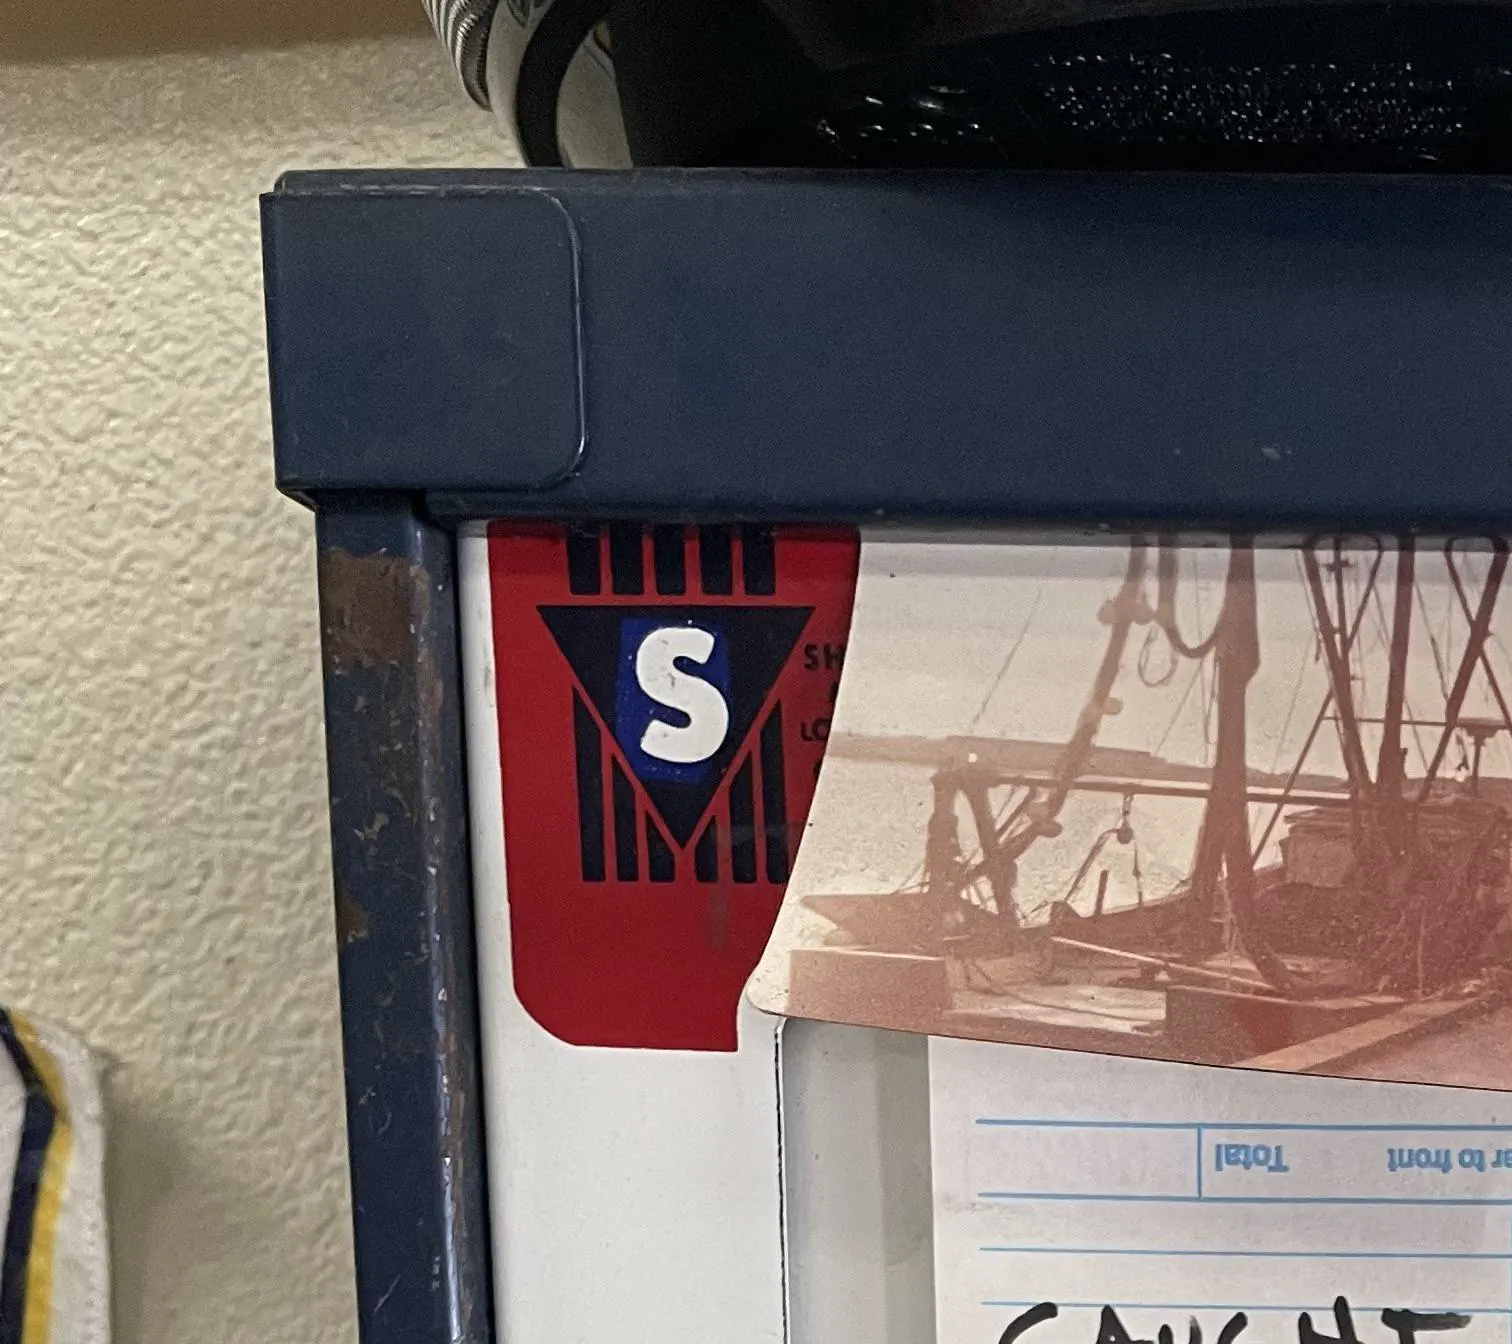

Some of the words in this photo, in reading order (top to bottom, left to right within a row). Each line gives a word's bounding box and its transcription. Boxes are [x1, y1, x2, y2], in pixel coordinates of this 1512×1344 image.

[634, 626, 730, 764] S
[1215, 1143, 1290, 1173] Total
[1387, 1148, 1454, 1174] front
[1458, 1148, 1486, 1173] to
